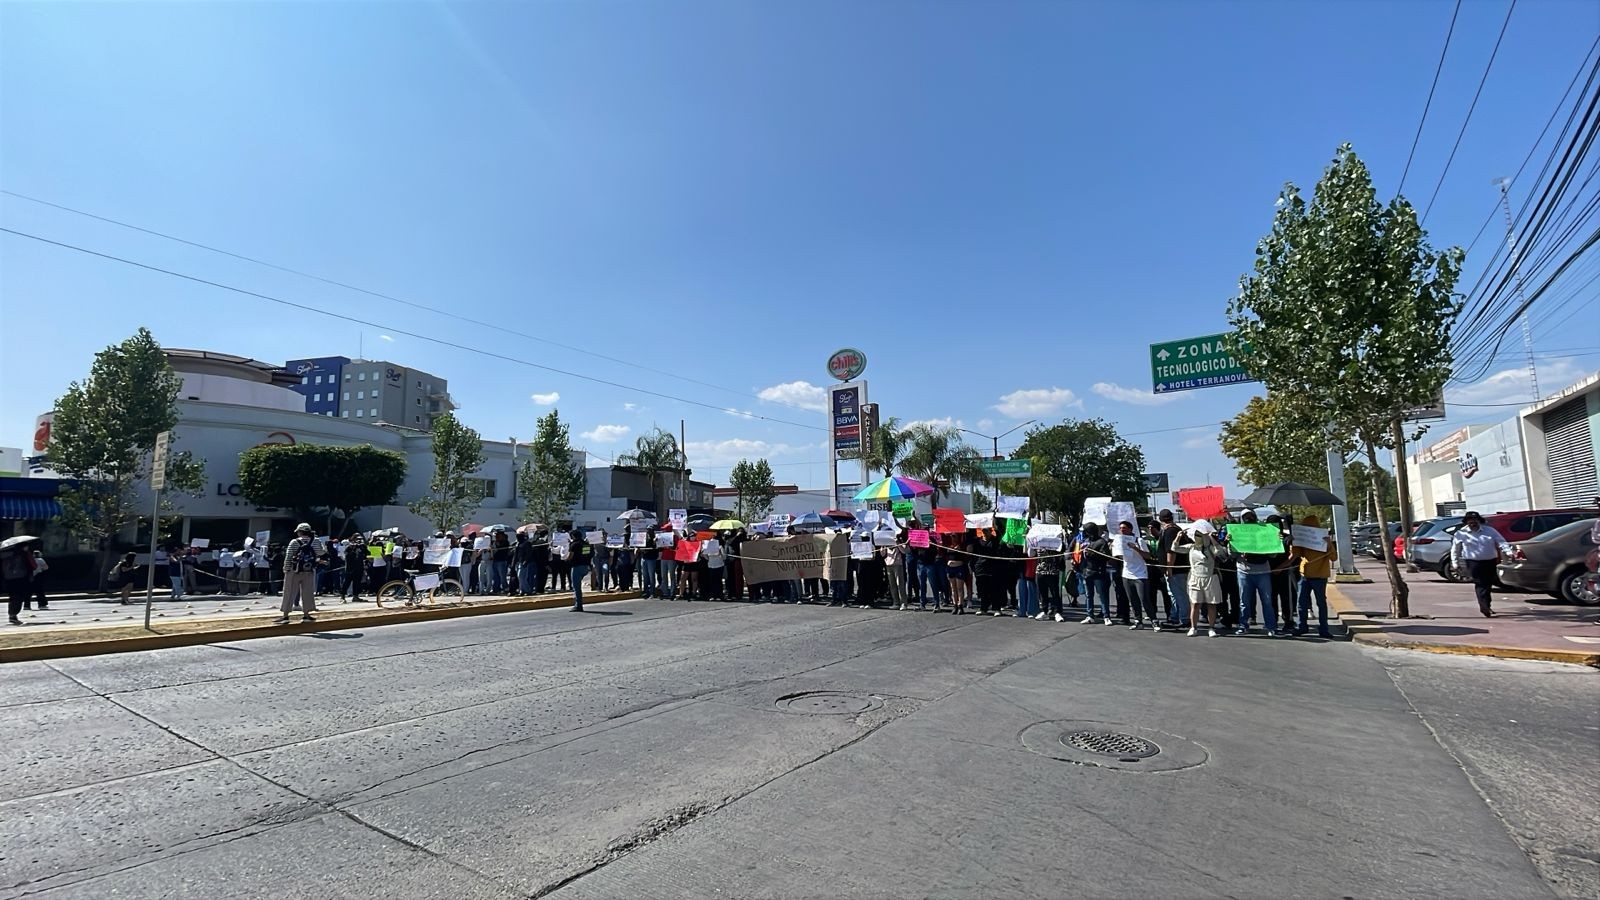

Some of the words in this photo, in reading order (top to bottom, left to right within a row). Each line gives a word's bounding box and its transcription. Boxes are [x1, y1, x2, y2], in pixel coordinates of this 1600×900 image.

[1178, 341, 1224, 358] ZONA
[1157, 358, 1226, 378] TECNOLOGICO
[1169, 381, 1195, 390] HOTEL
[1197, 373, 1247, 385] TERRANOVA
[836, 415, 858, 425] BBVA
